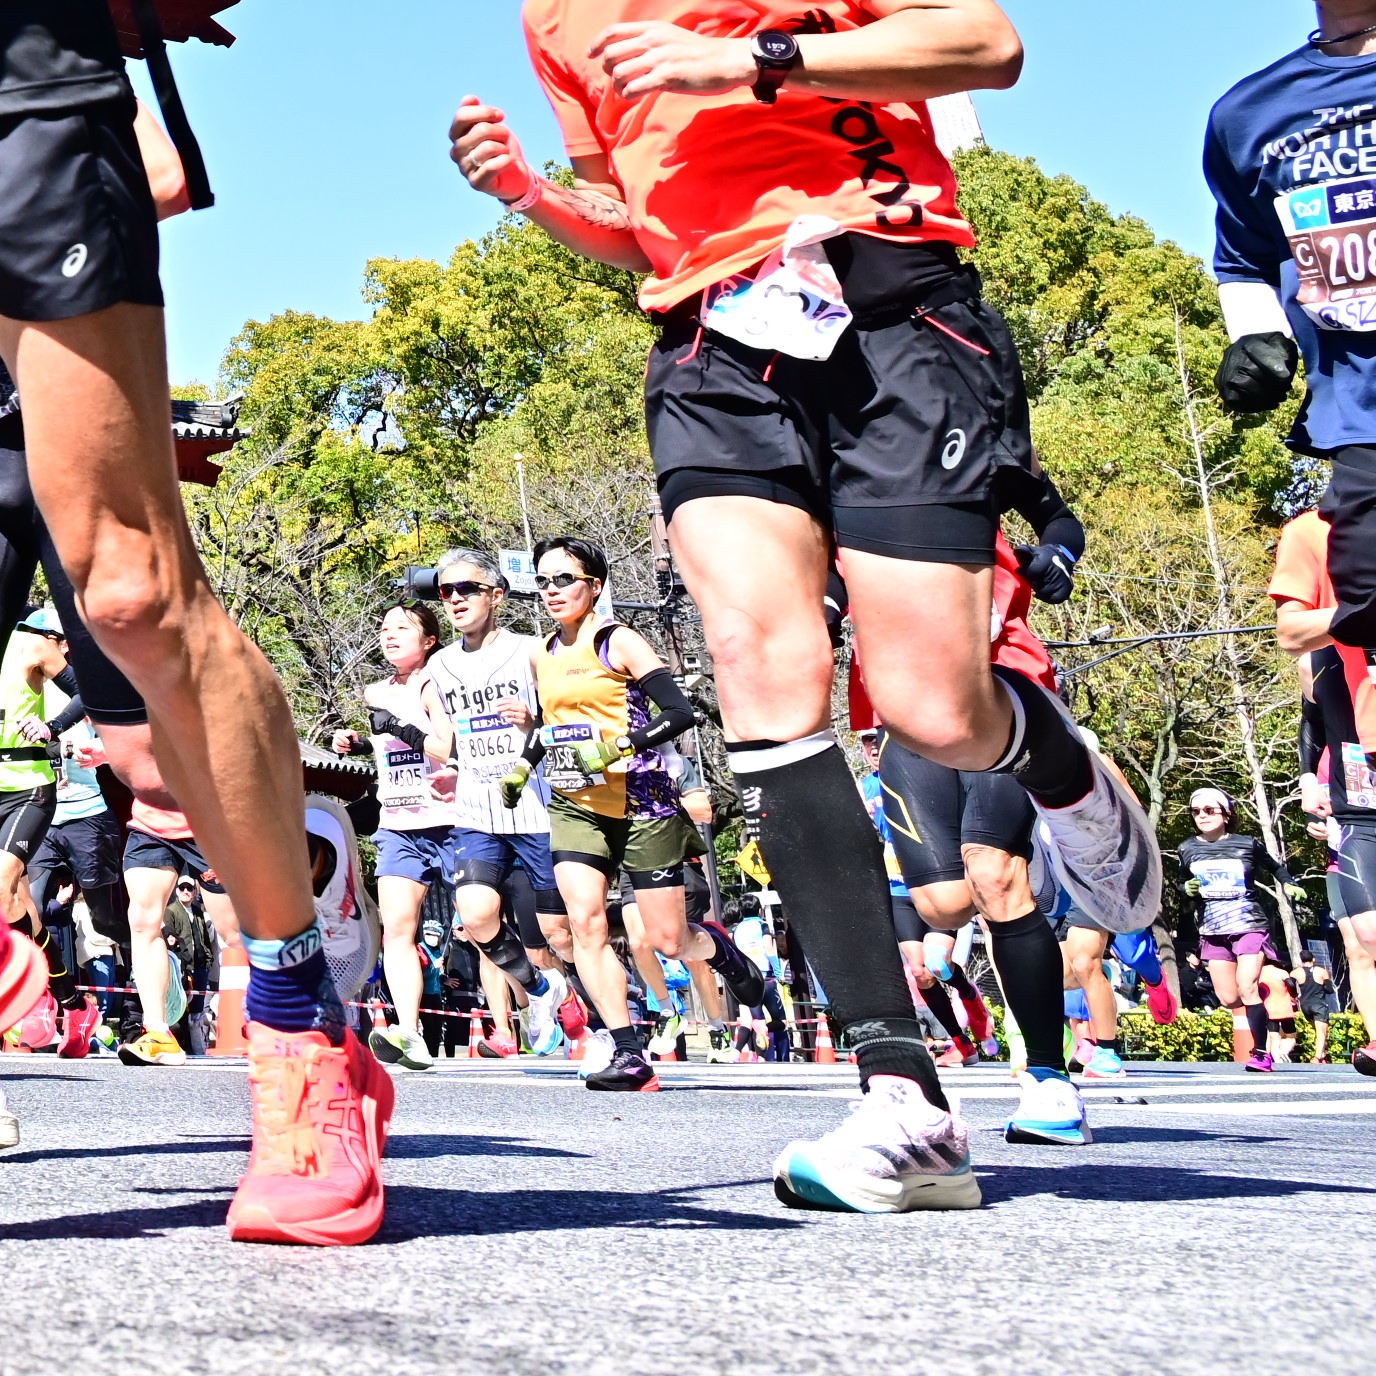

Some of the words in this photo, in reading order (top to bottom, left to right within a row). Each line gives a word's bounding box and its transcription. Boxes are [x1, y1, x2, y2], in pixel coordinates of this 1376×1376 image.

[1313, 104, 1373, 126] THE
[1263, 120, 1376, 164] NORTH
[1292, 147, 1376, 181] FACE
[1297, 243, 1314, 267] C
[508, 556, 536, 574] 増上
[446, 679, 519, 715] Tigers
[390, 752, 421, 763] 東京メトロ
[469, 734, 516, 758] 80662
